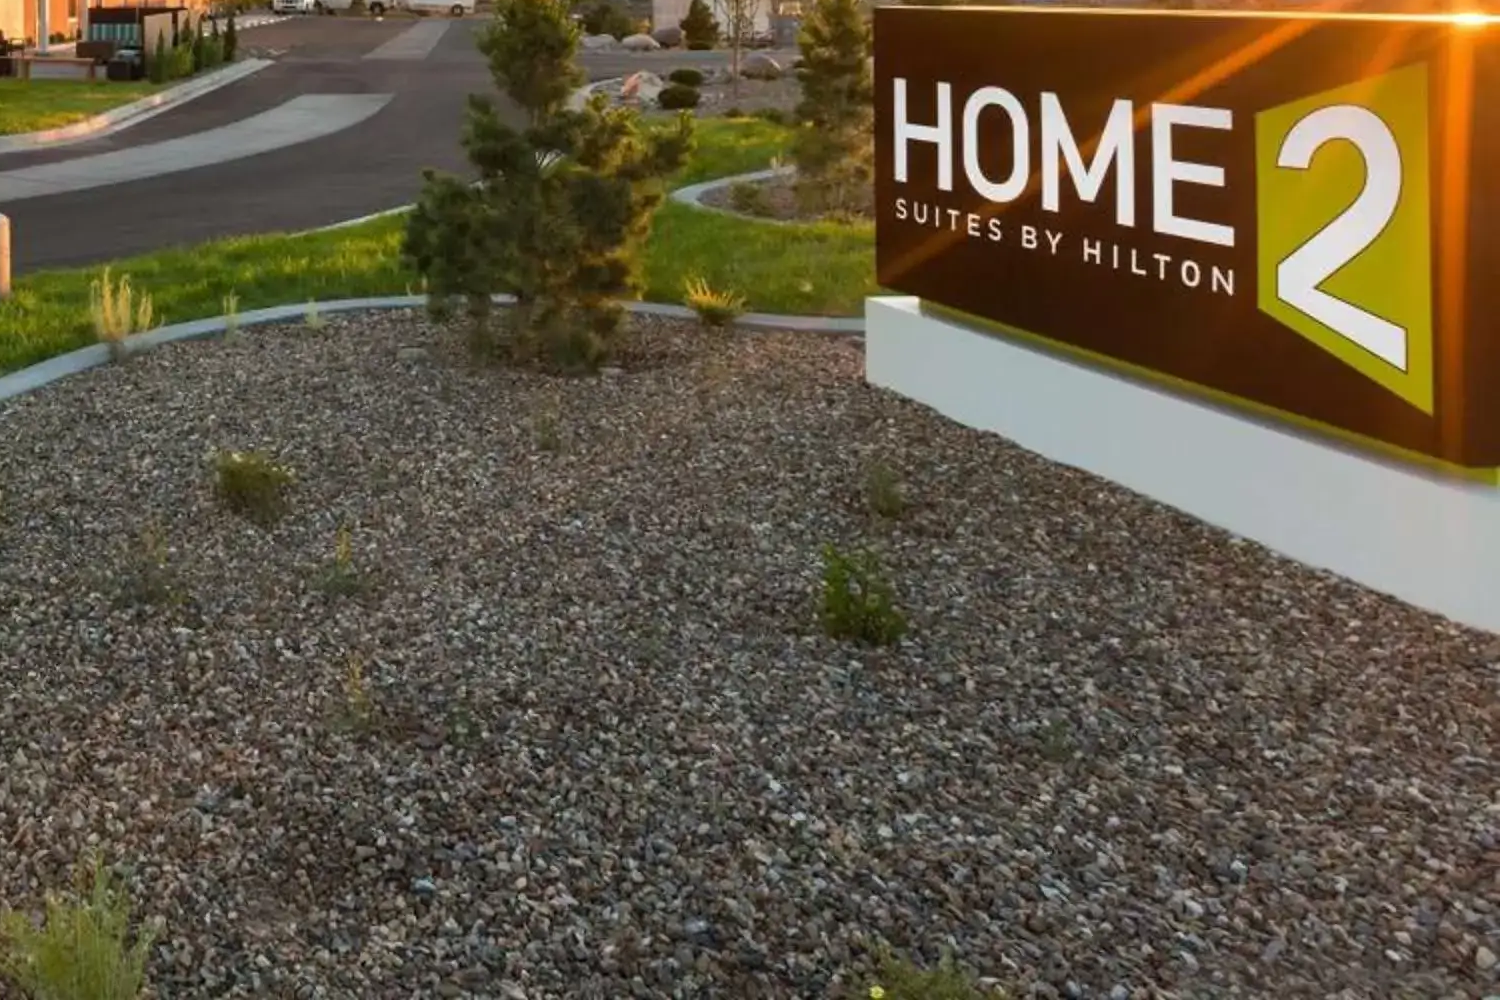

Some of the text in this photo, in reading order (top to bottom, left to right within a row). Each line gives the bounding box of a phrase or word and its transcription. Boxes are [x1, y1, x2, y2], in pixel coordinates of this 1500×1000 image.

[894, 77, 1408, 374] HOME 2
[895, 198, 1235, 296] SUITES BY HILTON
